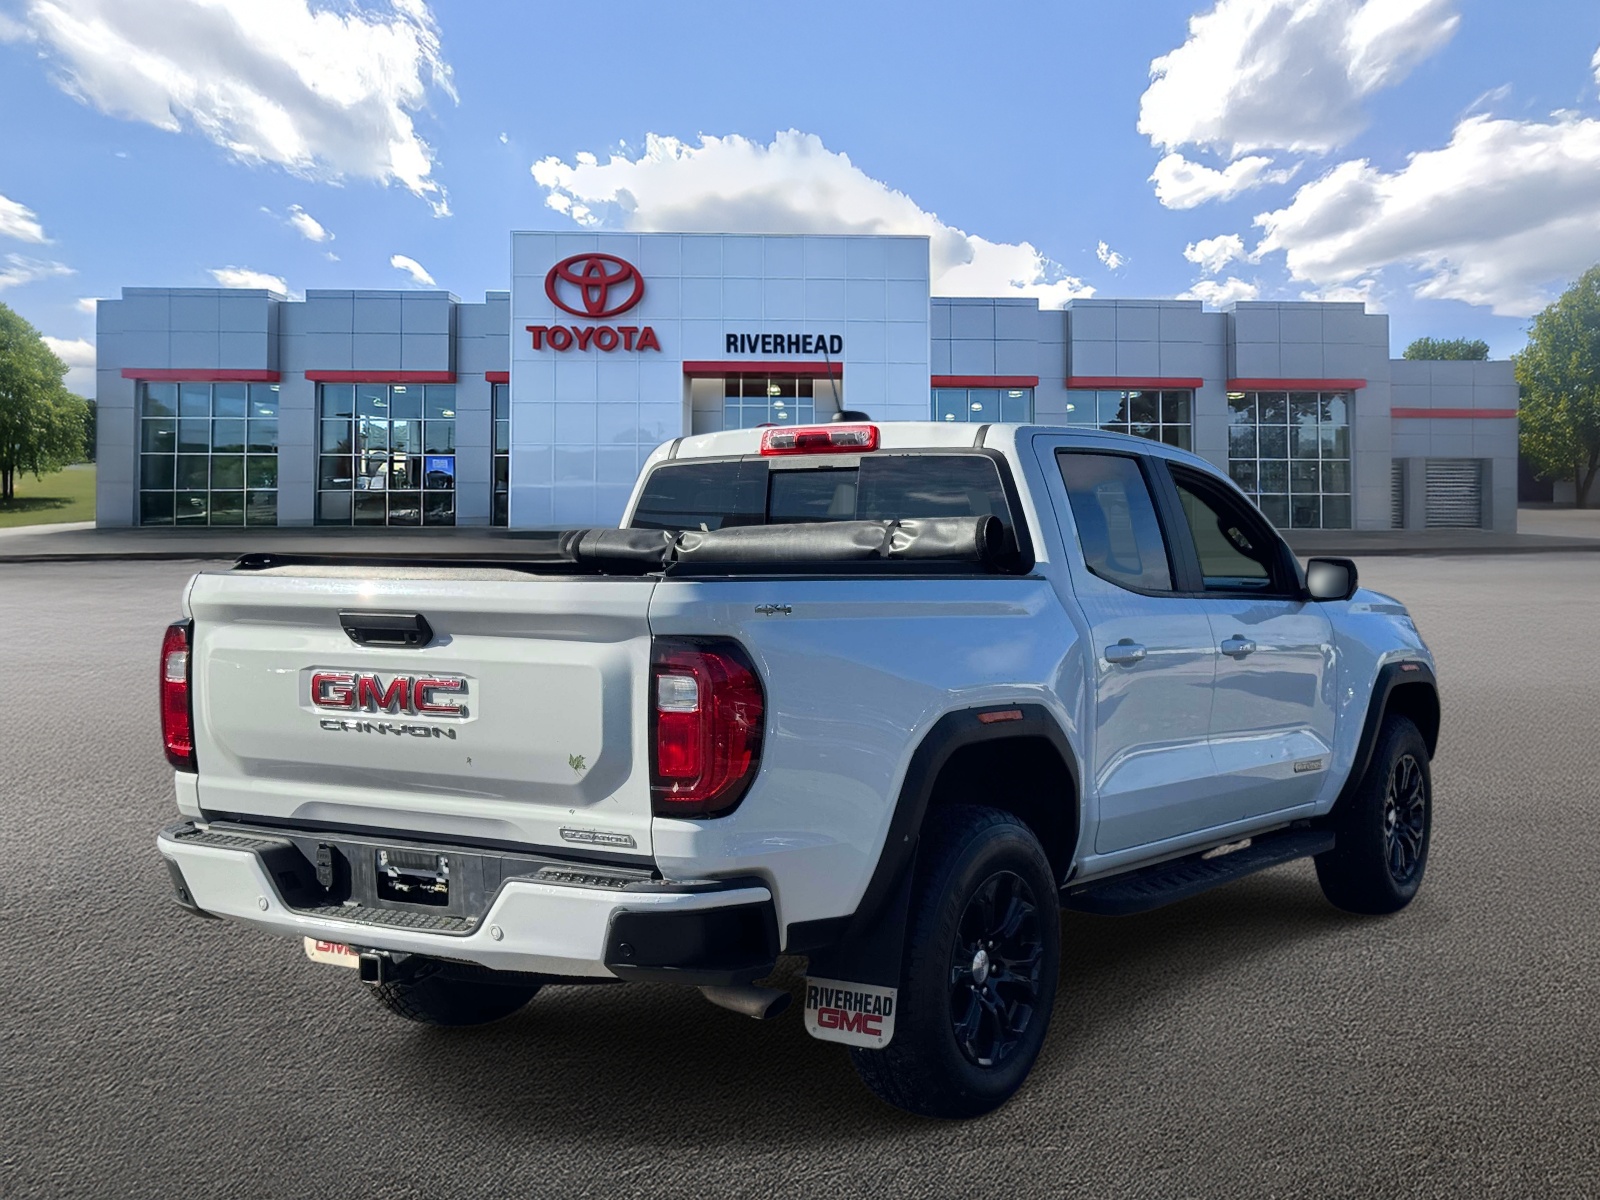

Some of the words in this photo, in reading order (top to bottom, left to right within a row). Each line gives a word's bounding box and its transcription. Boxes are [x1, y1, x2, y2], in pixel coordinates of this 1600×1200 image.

[525, 325, 661, 351] TOYOTA
[726, 334, 843, 354] RIVERHEAD
[311, 672, 470, 718] GMC
[319, 719, 457, 740] CANYON
[807, 985, 893, 1016] RIVERHEAD
[818, 1007, 883, 1036] GMC
